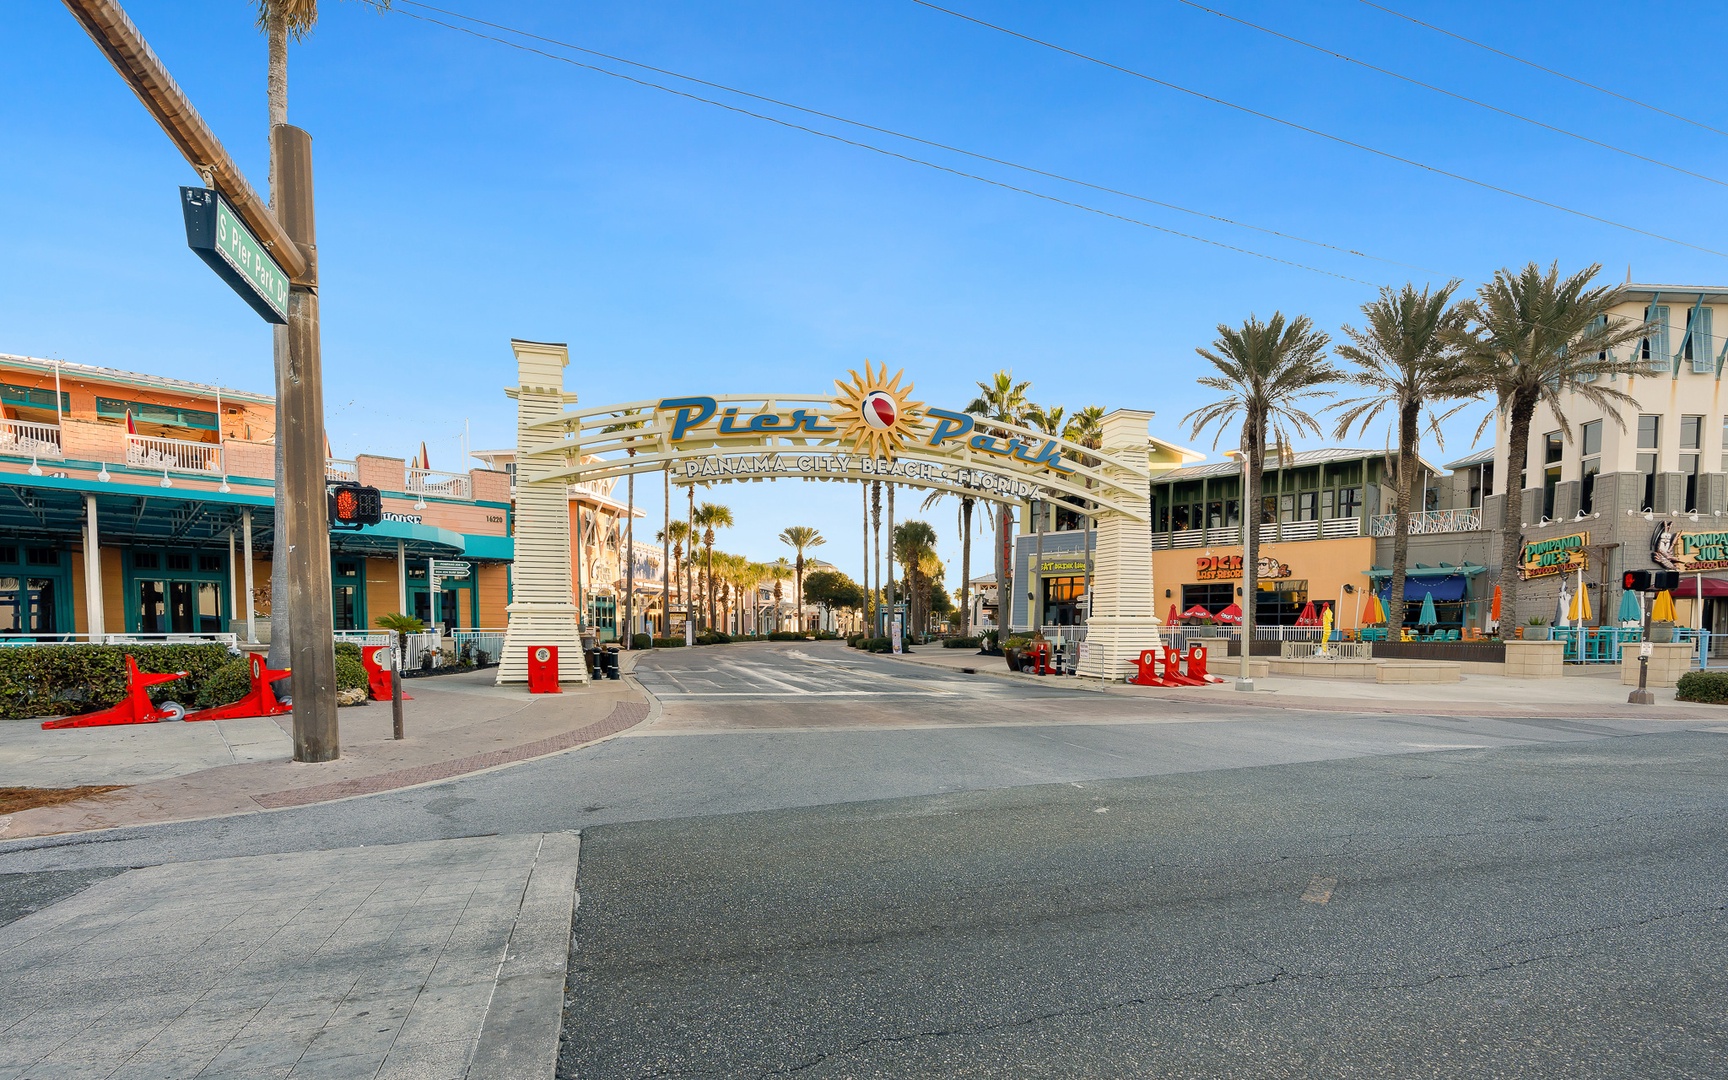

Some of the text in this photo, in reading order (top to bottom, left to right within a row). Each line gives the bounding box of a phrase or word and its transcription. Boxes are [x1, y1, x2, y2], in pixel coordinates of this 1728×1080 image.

[220, 213, 287, 306] S Pier Park Dr
[656, 396, 1076, 474] Pier Park
[685, 455, 1041, 501] PANAMA CITY BEACH FLORIDA
[486, 515, 503, 524] 16220
[1681, 533, 1728, 555] POMPA
[1197, 555, 1243, 571] DICK
[1196, 570, 1217, 580] LAST
